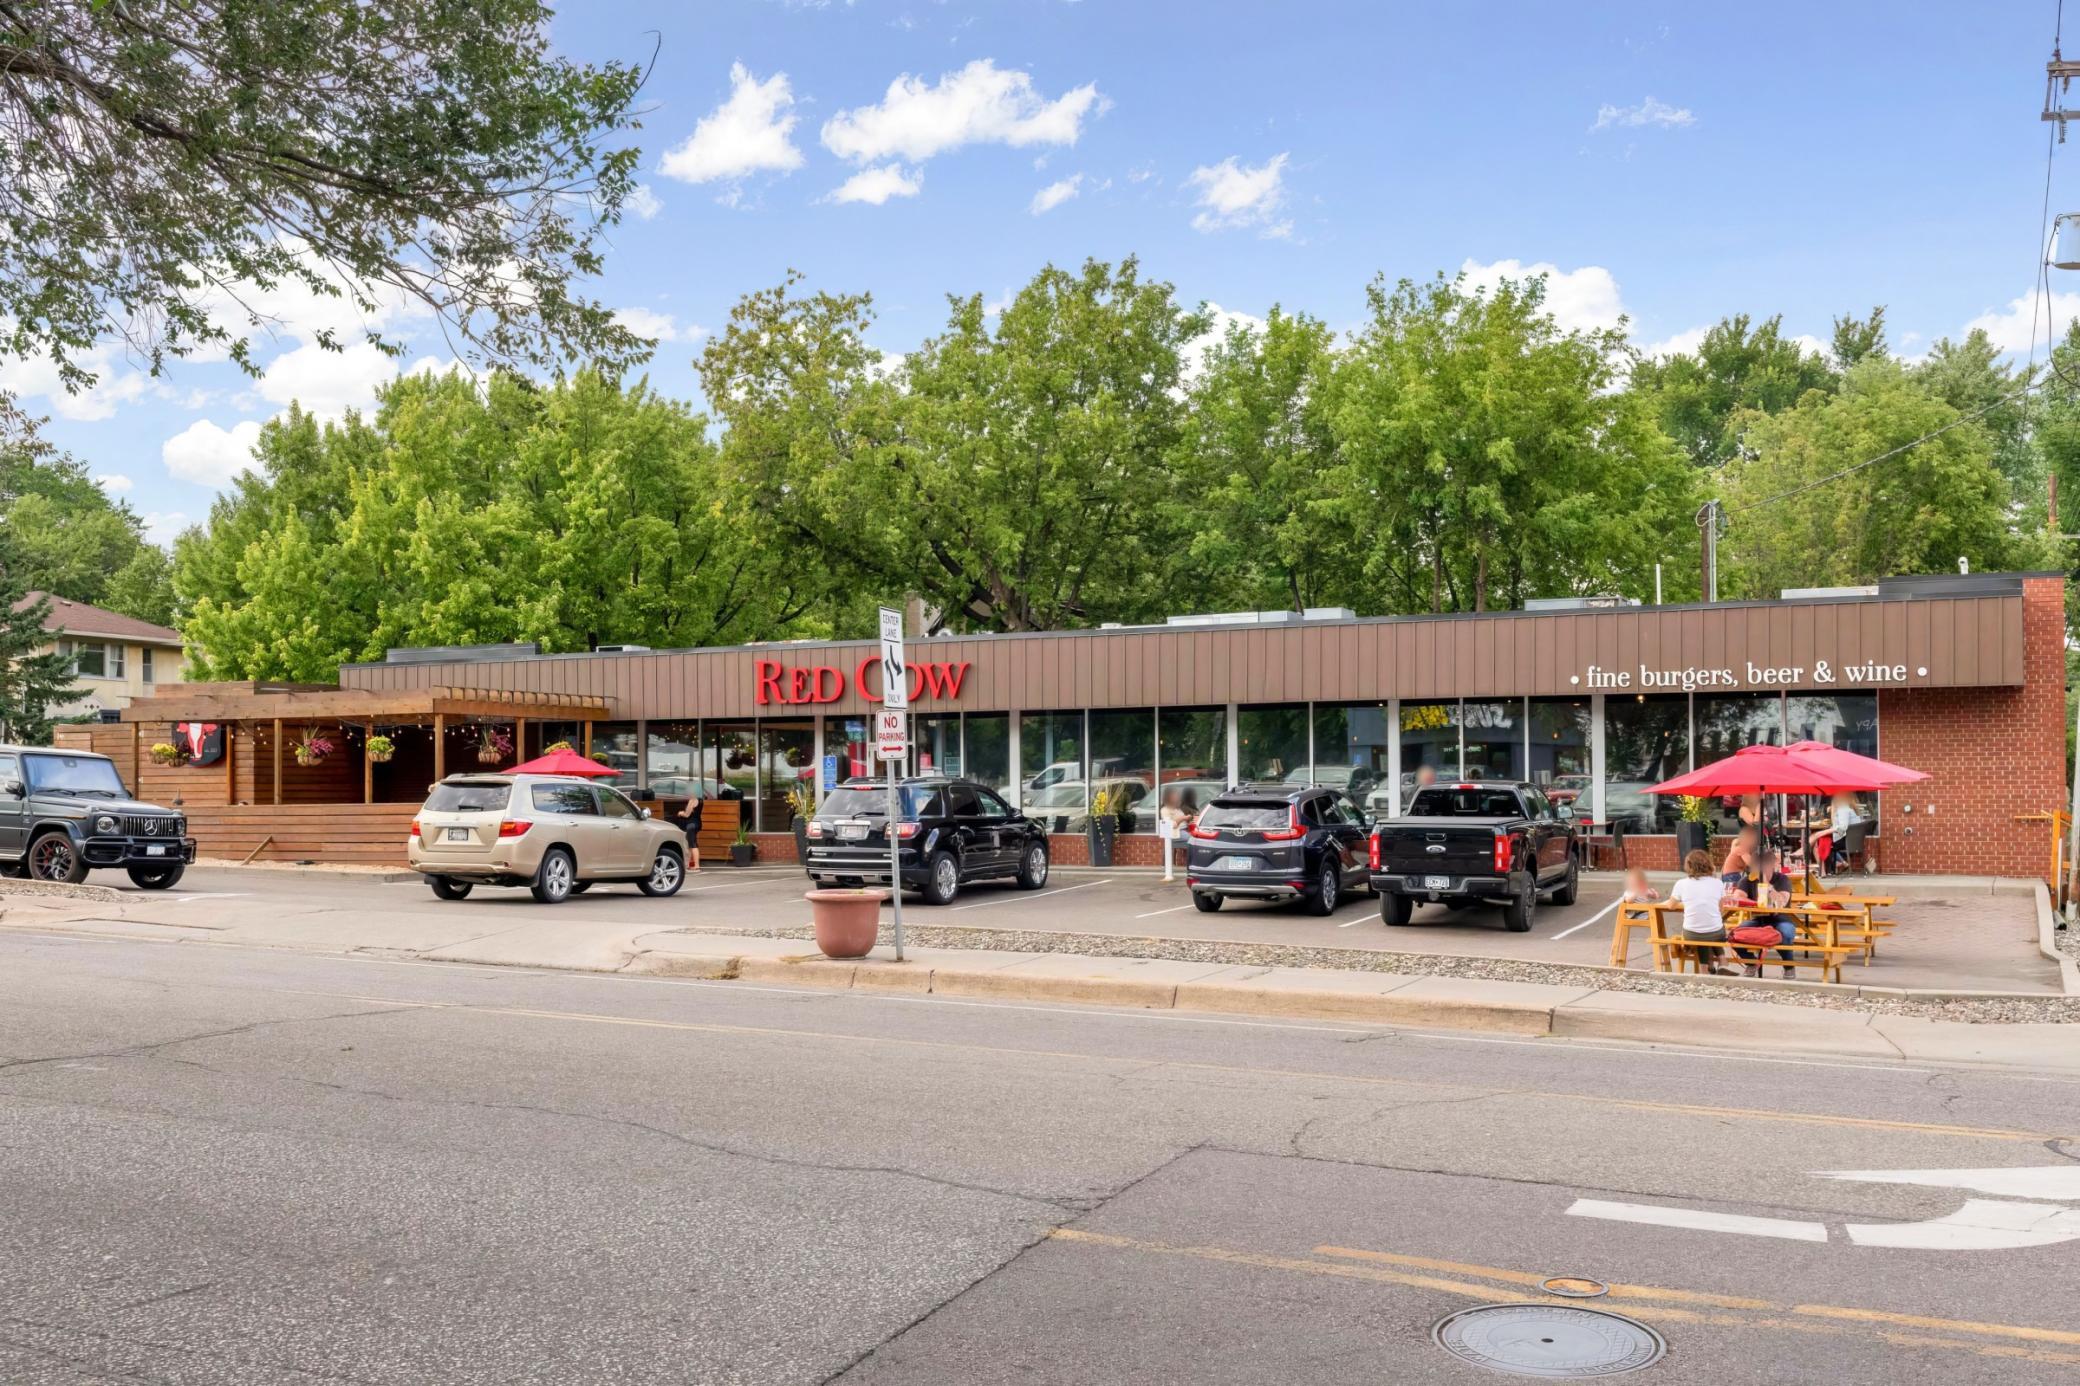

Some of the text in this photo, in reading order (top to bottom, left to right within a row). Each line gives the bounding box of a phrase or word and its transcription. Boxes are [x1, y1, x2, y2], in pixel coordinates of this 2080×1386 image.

[882, 613, 899, 626] CENTER
[1586, 659, 1907, 692] fine burgers, beer & wine
[754, 660, 845, 705] RED
[884, 716, 898, 729] NO
[879, 732, 905, 742] PARKING
